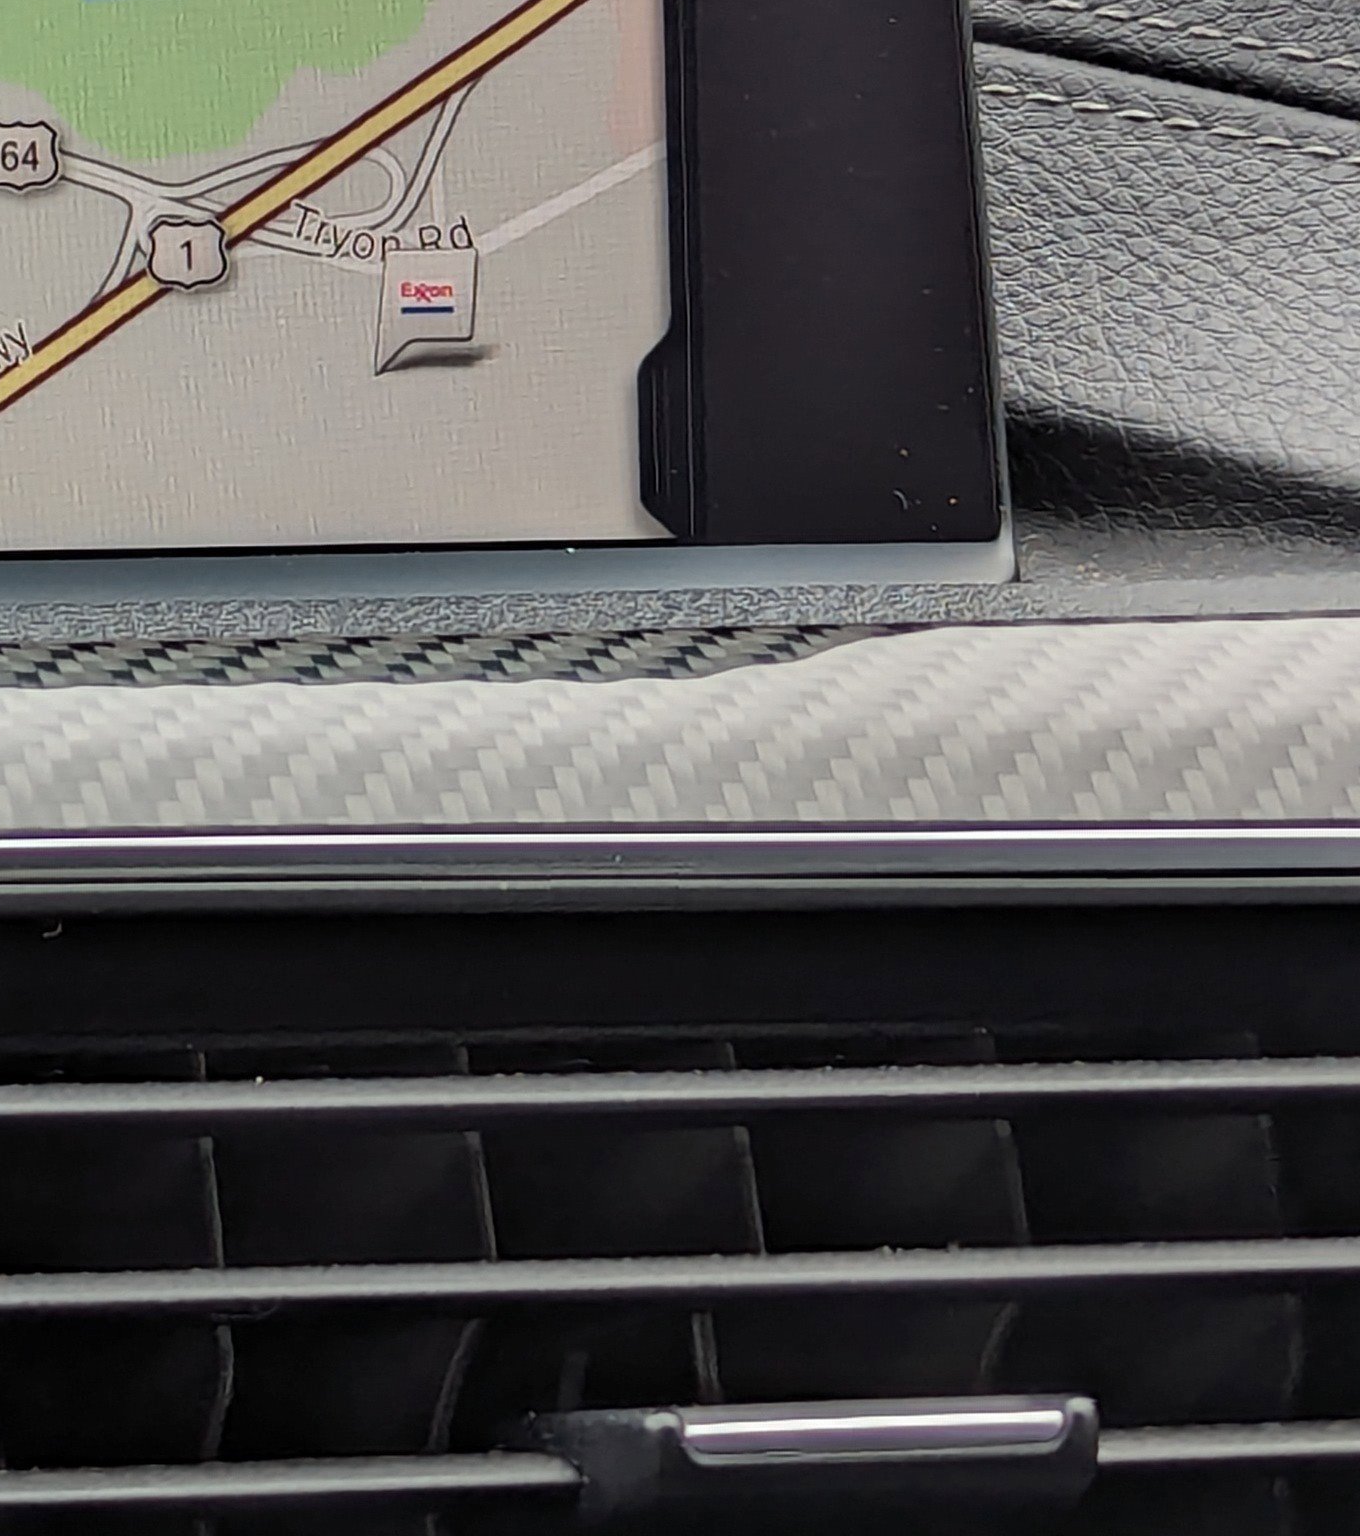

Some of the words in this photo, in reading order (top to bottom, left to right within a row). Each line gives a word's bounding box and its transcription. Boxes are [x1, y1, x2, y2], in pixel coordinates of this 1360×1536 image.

[0, 140, 41, 174] 64
[295, 202, 401, 261] Tryon
[180, 238, 194, 272] 1
[401, 282, 453, 302] Exxon
